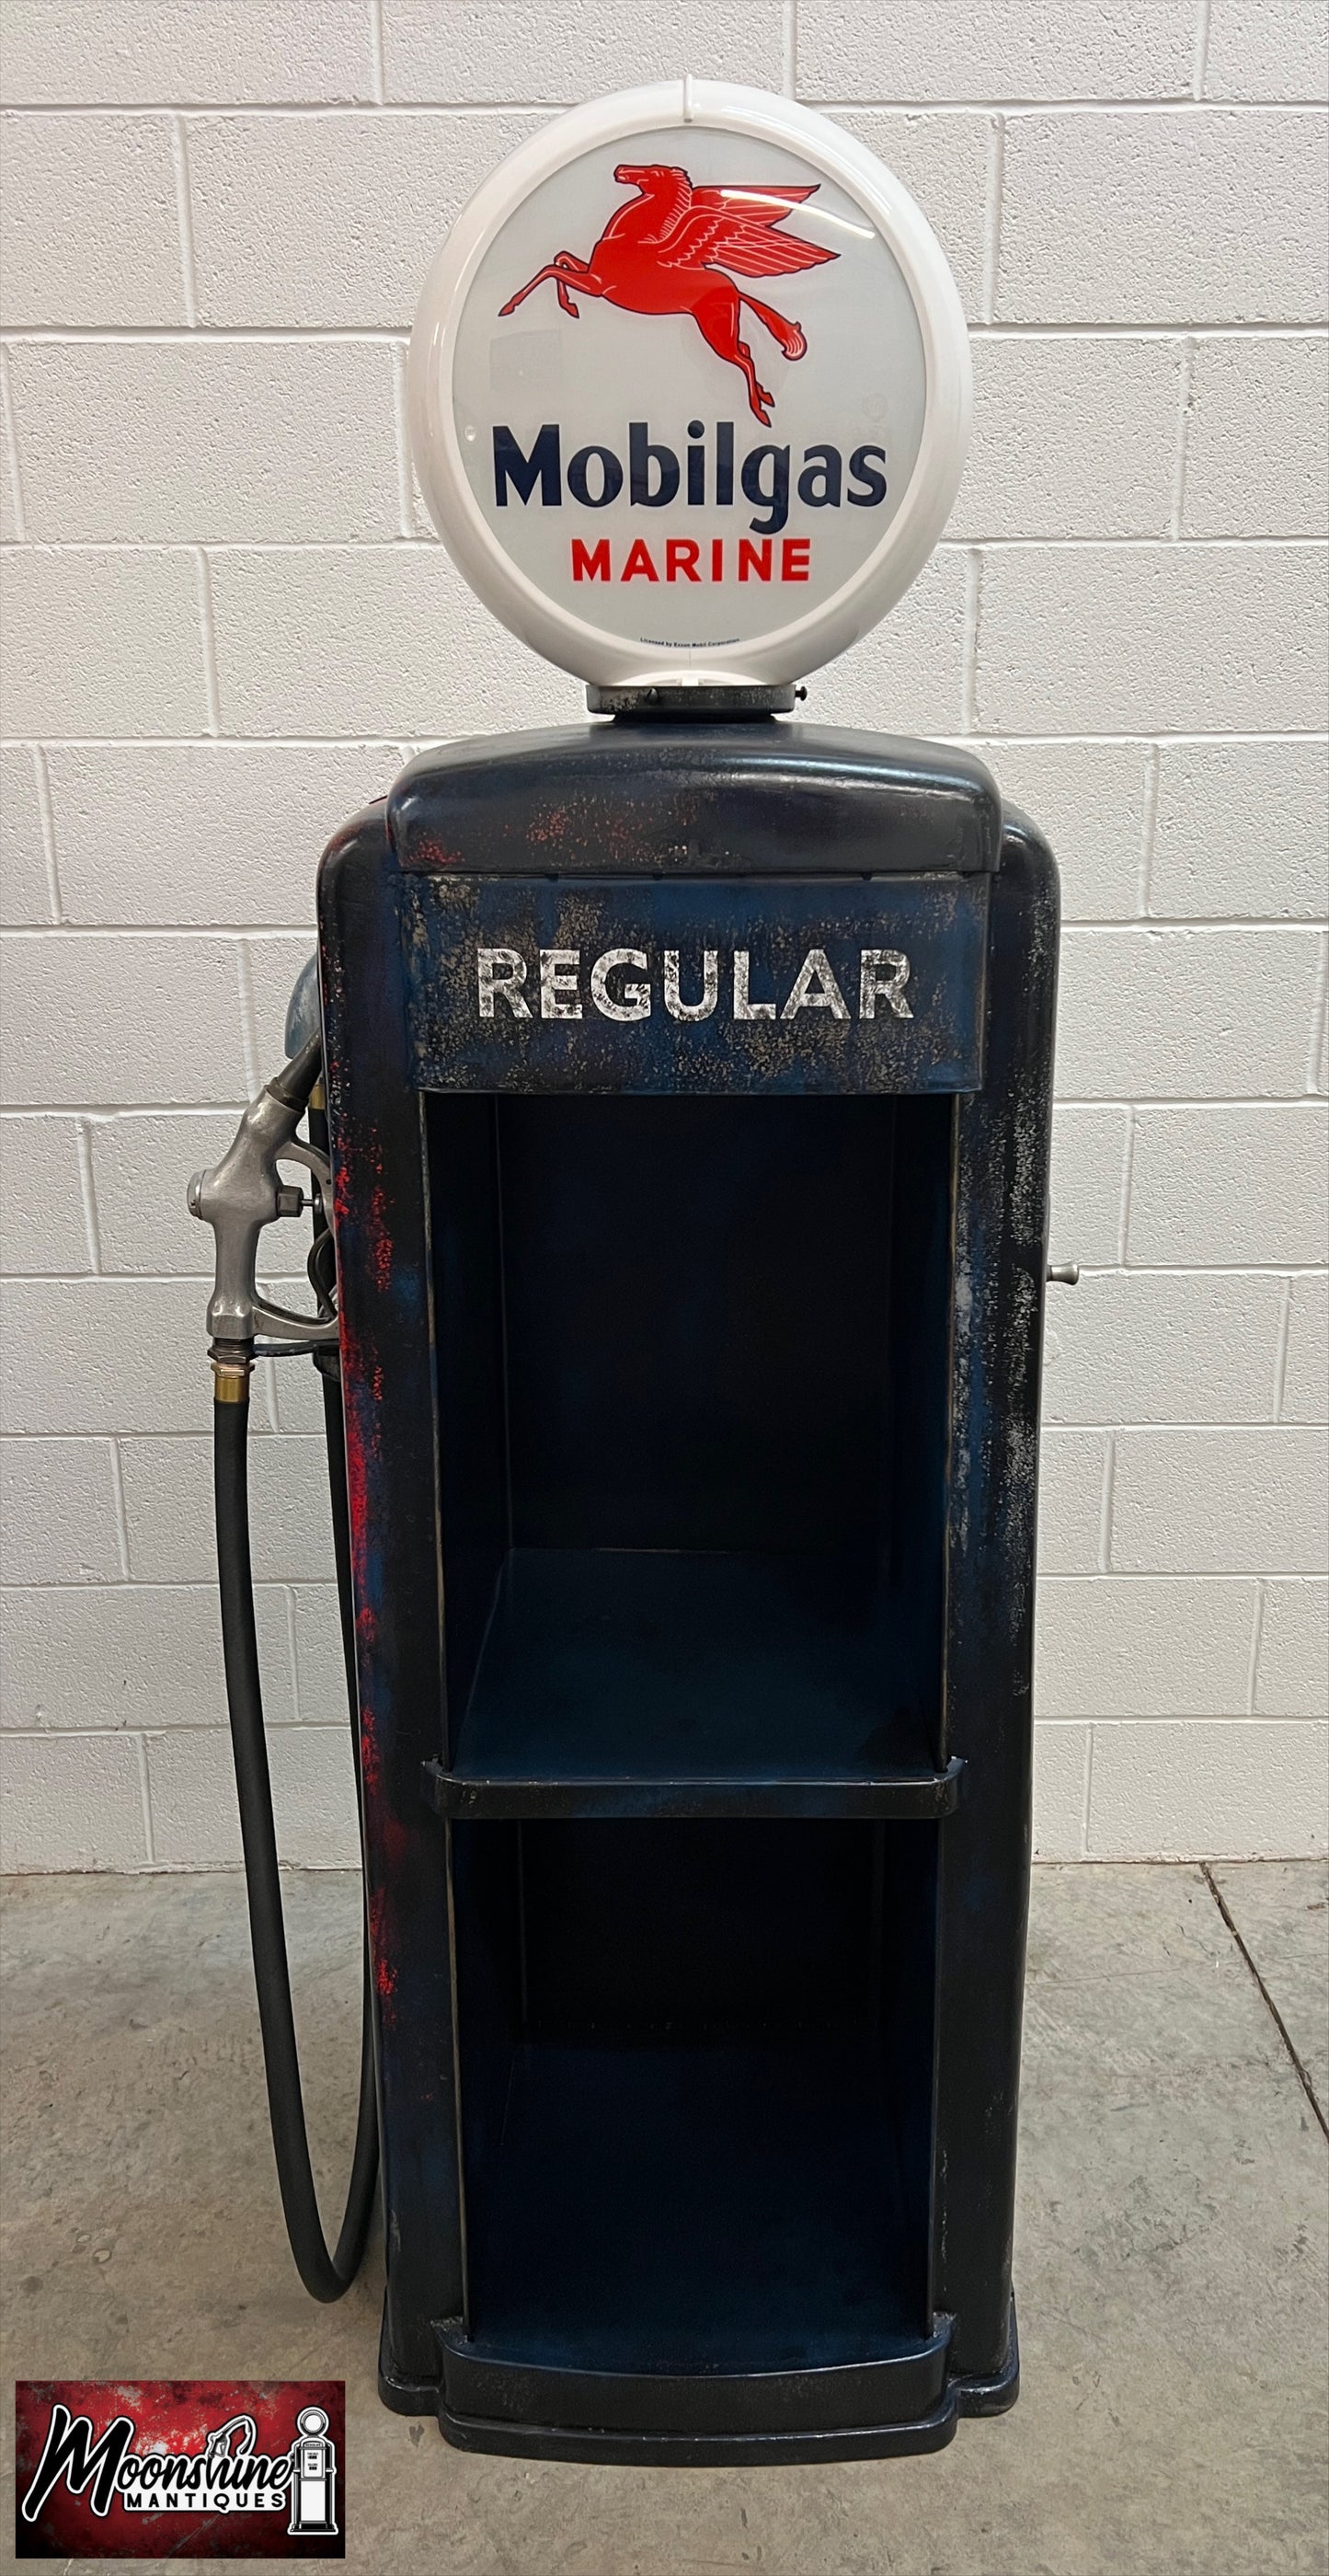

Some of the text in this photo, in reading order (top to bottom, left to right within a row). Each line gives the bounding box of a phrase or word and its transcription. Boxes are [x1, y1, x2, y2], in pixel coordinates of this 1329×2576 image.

[493, 420, 888, 535] Mobilgas
[571, 538, 809, 582] MARINE
[640, 637, 665, 646] Licensed
[708, 638, 739, 647] Corporation
[476, 948, 914, 1022] REGULAR
